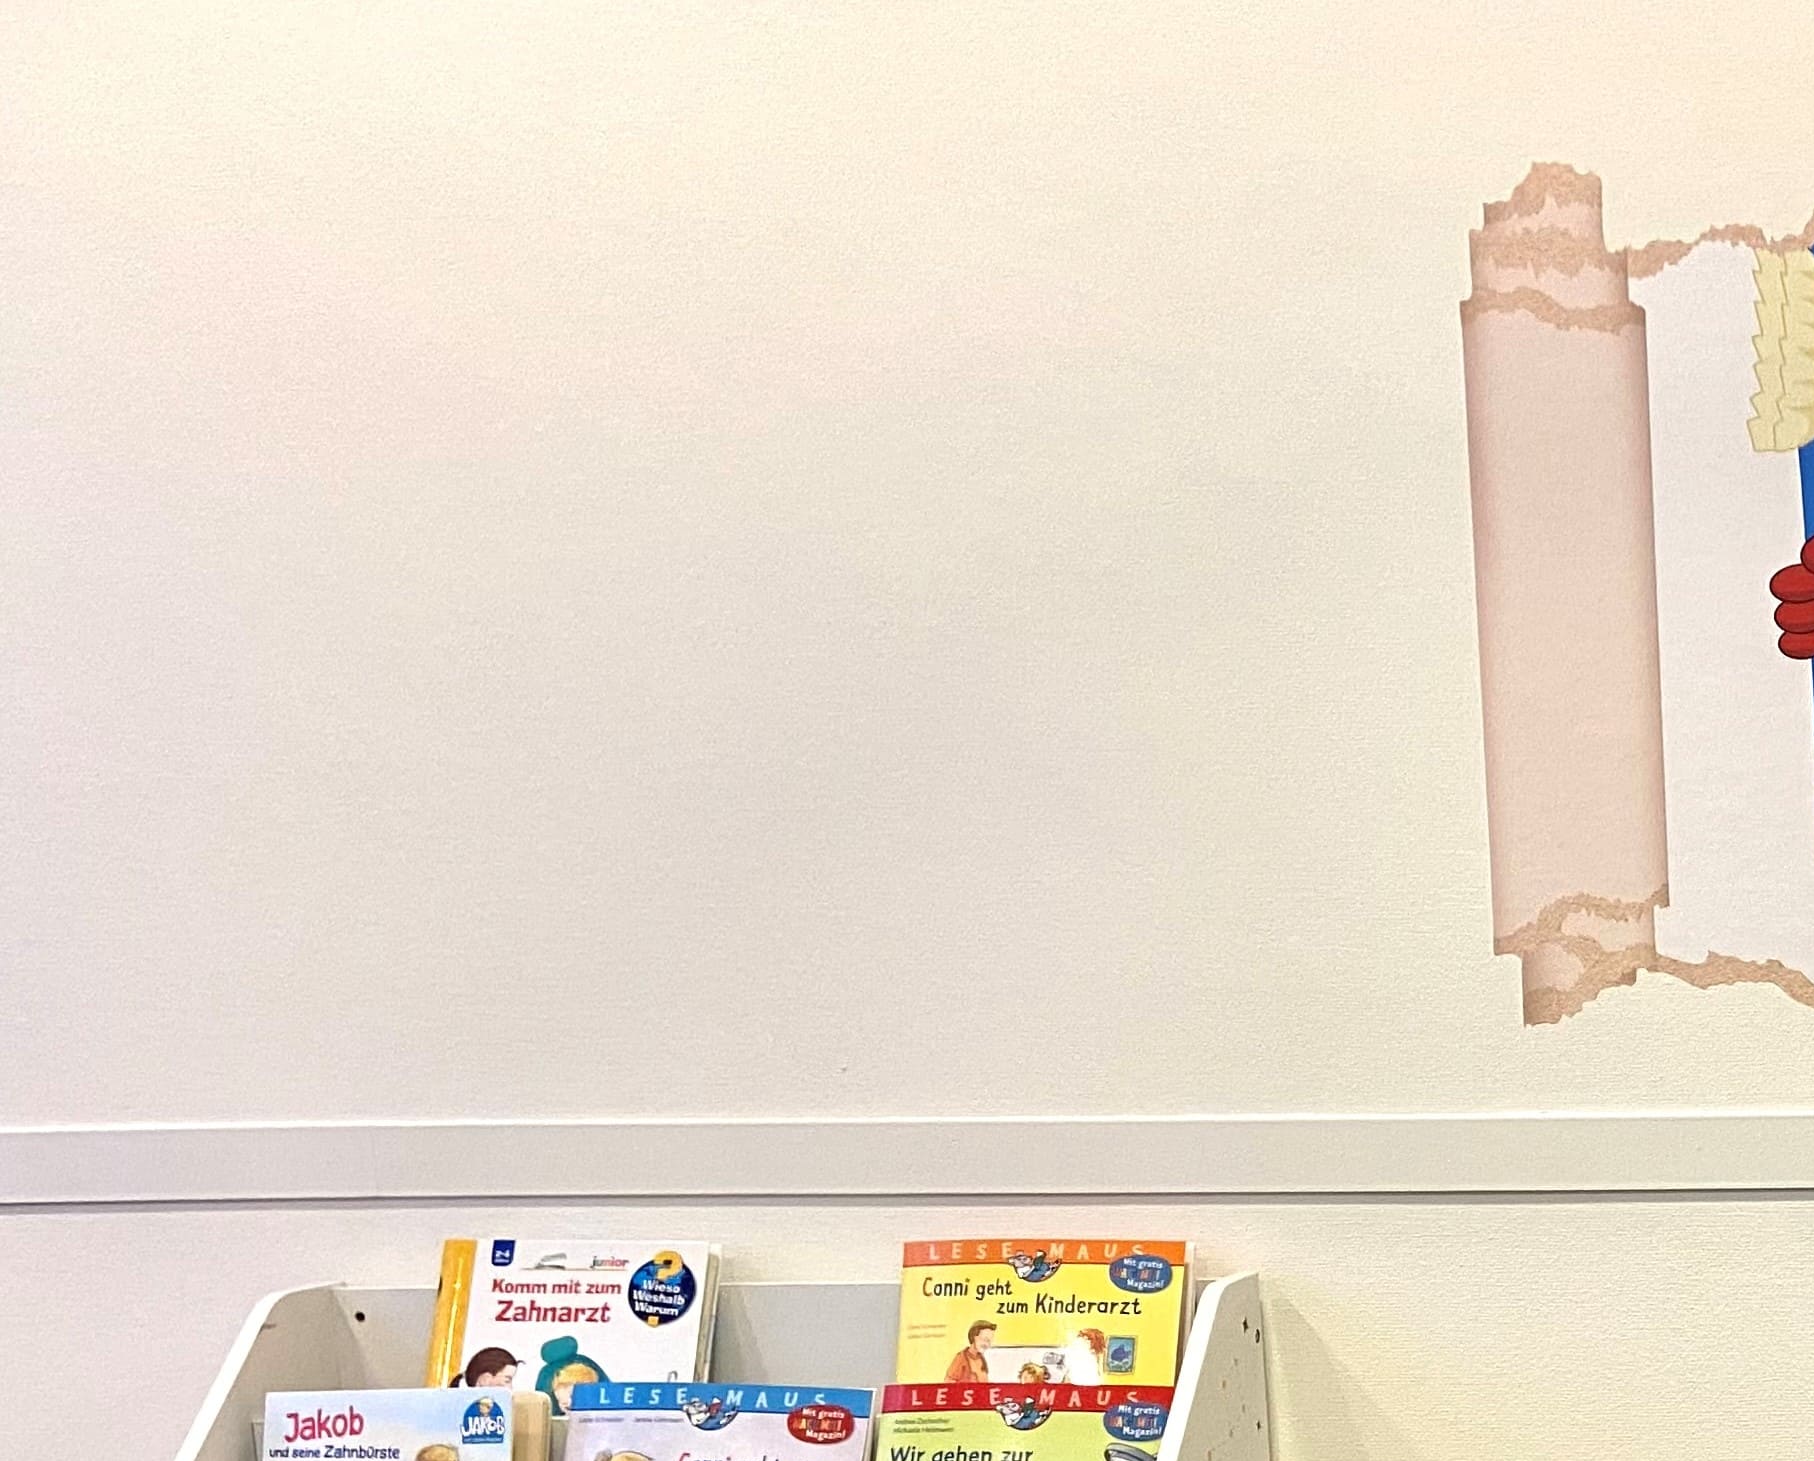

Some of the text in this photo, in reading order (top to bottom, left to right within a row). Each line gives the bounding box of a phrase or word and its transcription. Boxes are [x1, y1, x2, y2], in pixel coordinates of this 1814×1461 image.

[929, 1242, 1144, 1260] LESE MAUS
[590, 1255, 629, 1269] junior
[492, 1279, 621, 1295] Komm mit zum
[643, 1280, 680, 1293] Wieso
[923, 1278, 1012, 1300] Conni geht
[633, 1290, 685, 1305] Weshalb
[996, 1293, 1142, 1315] zum Kinderarzt
[495, 1300, 611, 1323] Zahnarzt
[635, 1301, 678, 1316] Warum
[600, 1387, 826, 1408] LESE MAUS
[912, 1388, 1138, 1407] LESE MAUS
[284, 1405, 365, 1443] Jakob
[461, 1416, 505, 1436] JAKOB
[269, 1444, 400, 1460] und seine Zahnbürste
